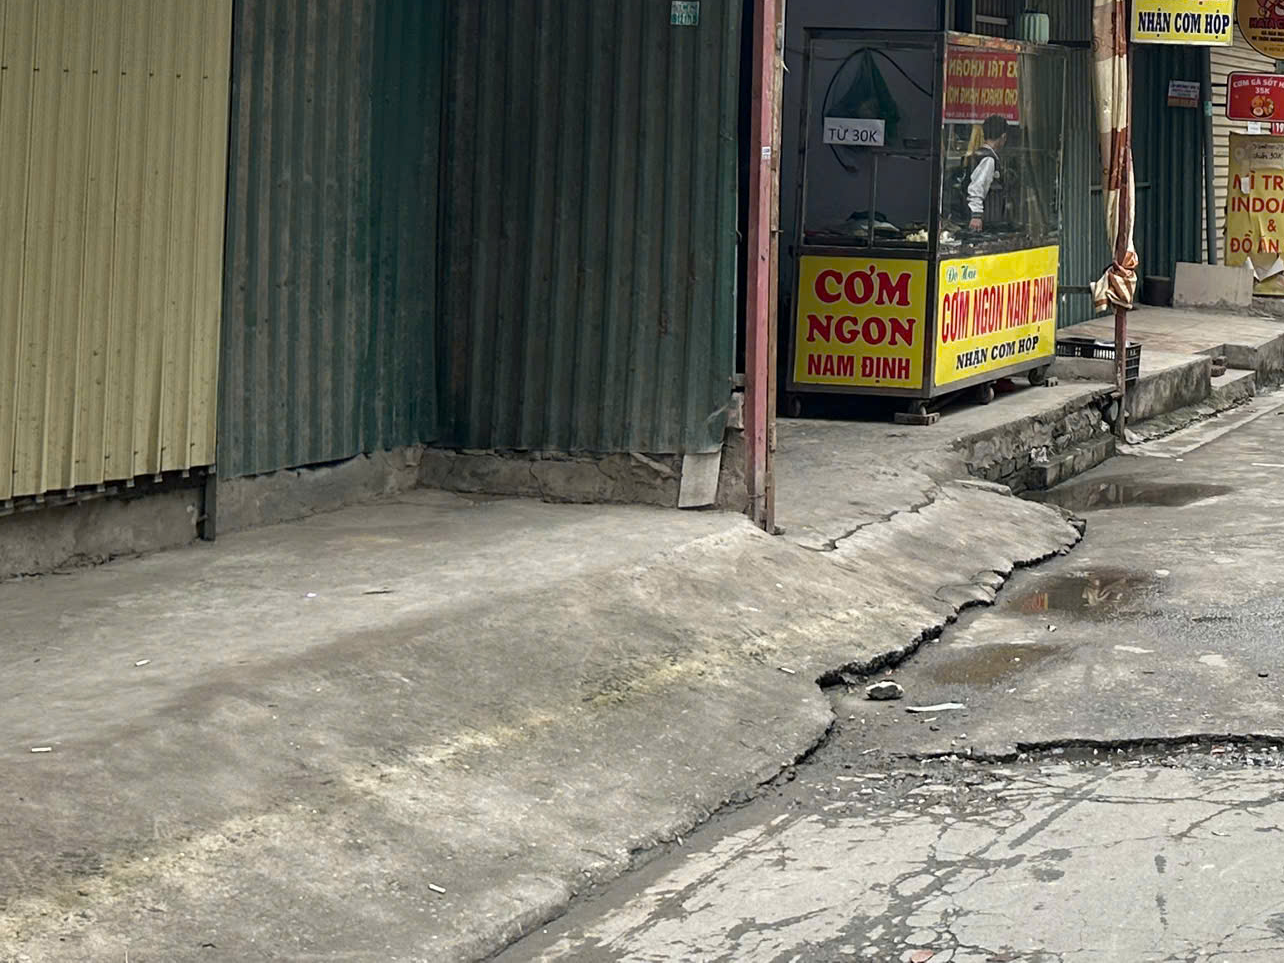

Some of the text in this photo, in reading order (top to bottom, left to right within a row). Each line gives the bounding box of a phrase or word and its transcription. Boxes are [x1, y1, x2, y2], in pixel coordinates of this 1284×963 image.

[1138, 8, 1230, 39] NHẬN CƠM HỘP
[1251, 78, 1262, 86] GÀ
[1255, 87, 1271, 95] 35K
[828, 125, 877, 142] TỪ 30K
[1267, 219, 1277, 232] &
[1230, 230, 1253, 253] ĐỒ
[814, 265, 912, 307] CƠM
[941, 286, 970, 344] CƠM
[971, 284, 1005, 337] NGON
[1006, 279, 1031, 329] NAM
[806, 314, 916, 347] NGON
[956, 333, 1039, 370] NHẬN CƠM HỘP
[808, 353, 911, 384] NAM ĐỊNH
